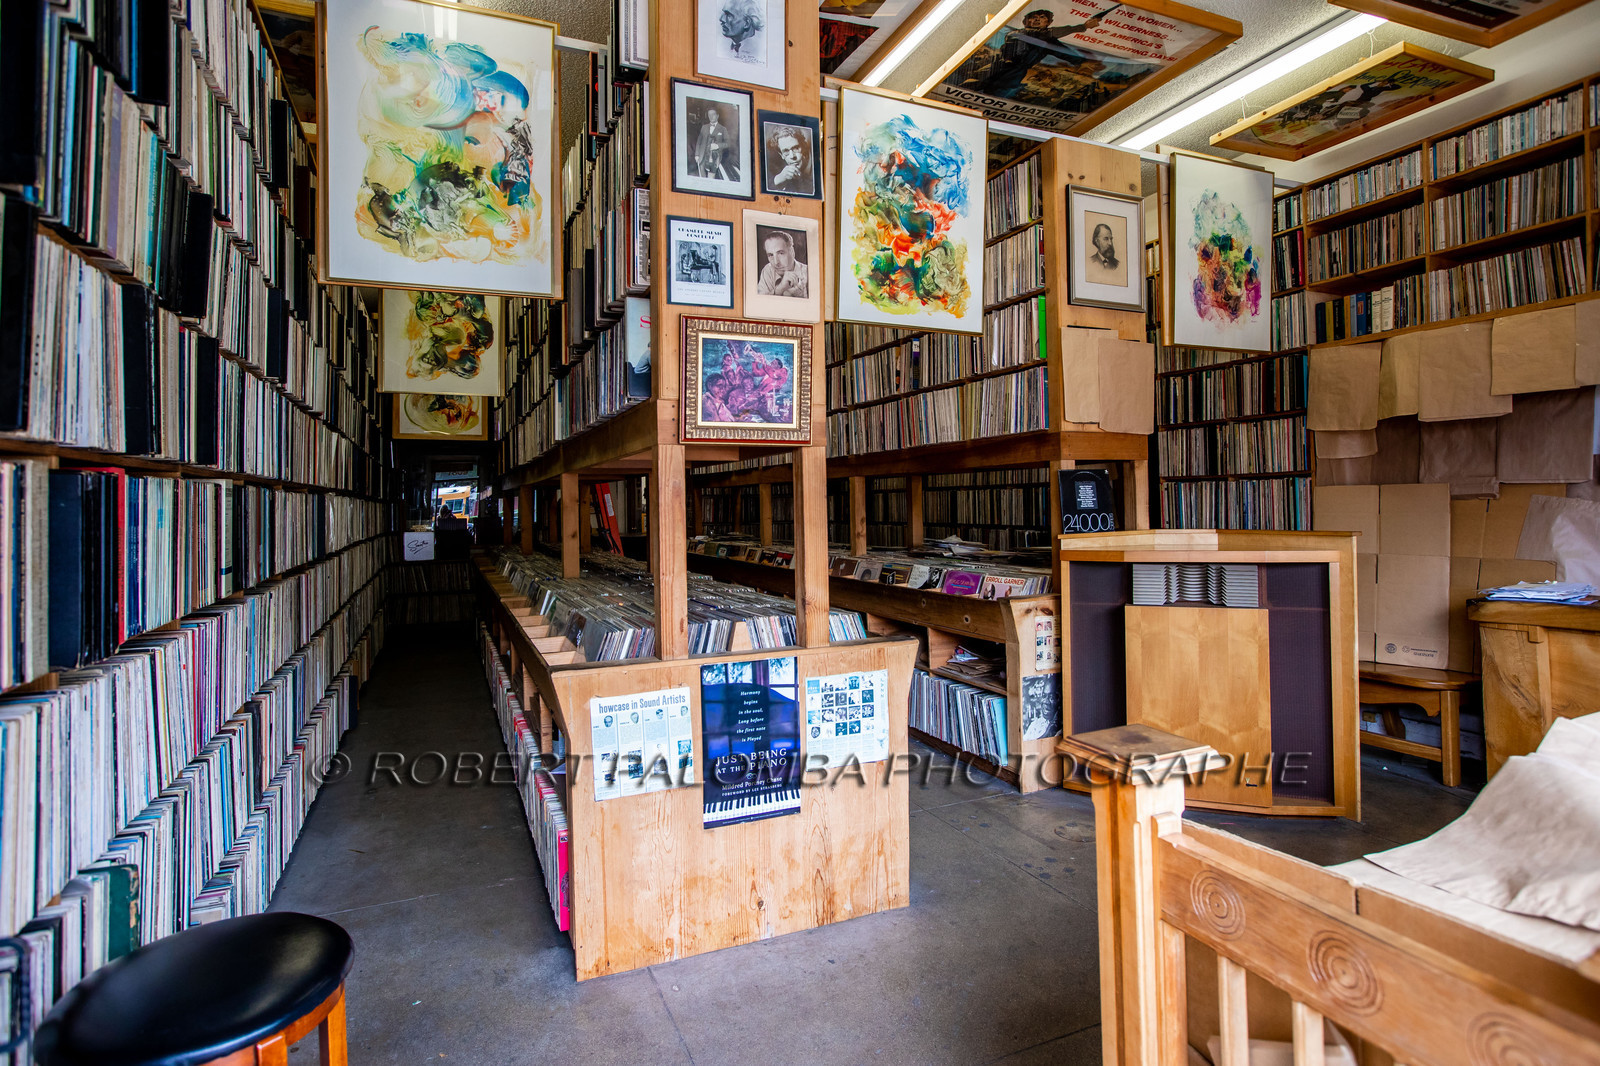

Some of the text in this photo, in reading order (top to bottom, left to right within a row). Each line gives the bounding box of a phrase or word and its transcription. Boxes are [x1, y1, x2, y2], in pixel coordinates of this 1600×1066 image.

[1070, 8, 1175, 42] THE WILDERNESS...
[1115, 9, 1136, 20] THE
[1136, 15, 1183, 33] WOMEN...
[1073, 33, 1178, 62] MOST EXCITING DAYS!
[1112, 34, 1163, 50] AMERICA'S
[945, 86, 1078, 121] VICTOR MATURE
[982, 109, 1059, 128] MADISON
[1063, 513, 1110, 534] 24000
[985, 576, 1004, 584] ERROLL
[1003, 578, 1026, 586] GARNER
[598, 694, 686, 714] howcase in Sound Artists
[715, 747, 787, 767] JUST BEING
[716, 757, 787, 775] AT THE PIANO
[722, 782, 744, 791] Mildred
